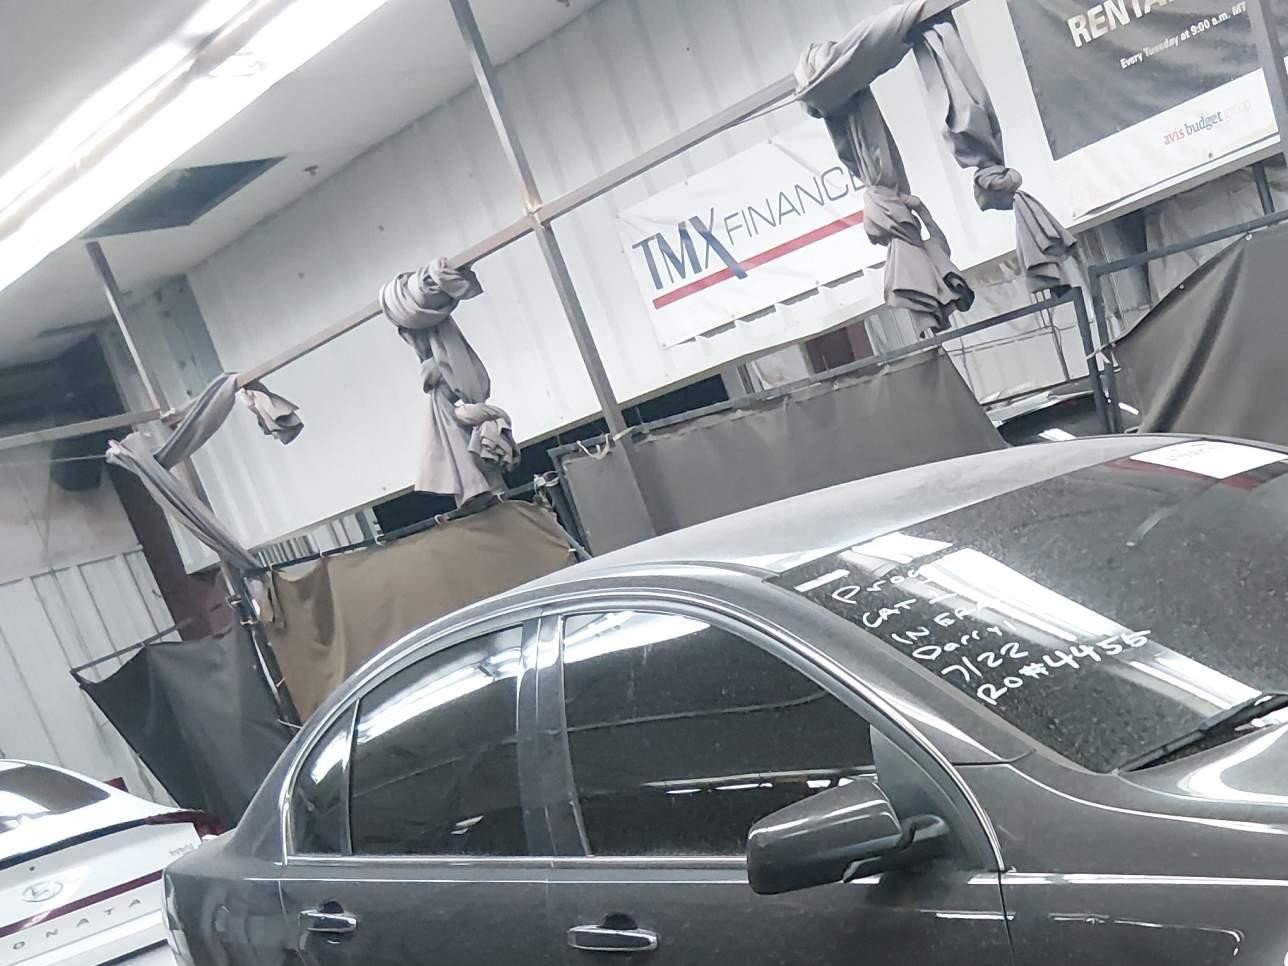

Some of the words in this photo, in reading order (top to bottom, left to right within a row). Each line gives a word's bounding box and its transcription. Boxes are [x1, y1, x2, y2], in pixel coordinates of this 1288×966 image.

[1120, 51, 1143, 69] Every
[1143, 35, 1179, 58] Tuesday
[1180, 28, 1191, 41] at
[1190, 19, 1211, 37] 9:00
[1212, 11, 1231, 26] a.m.
[1231, 1, 1247, 16] MT
[1163, 128, 1185, 145] avis
[1184, 111, 1224, 136] budget
[632, 207, 748, 290] TMX
[941, 642, 1029, 683] 7/22
